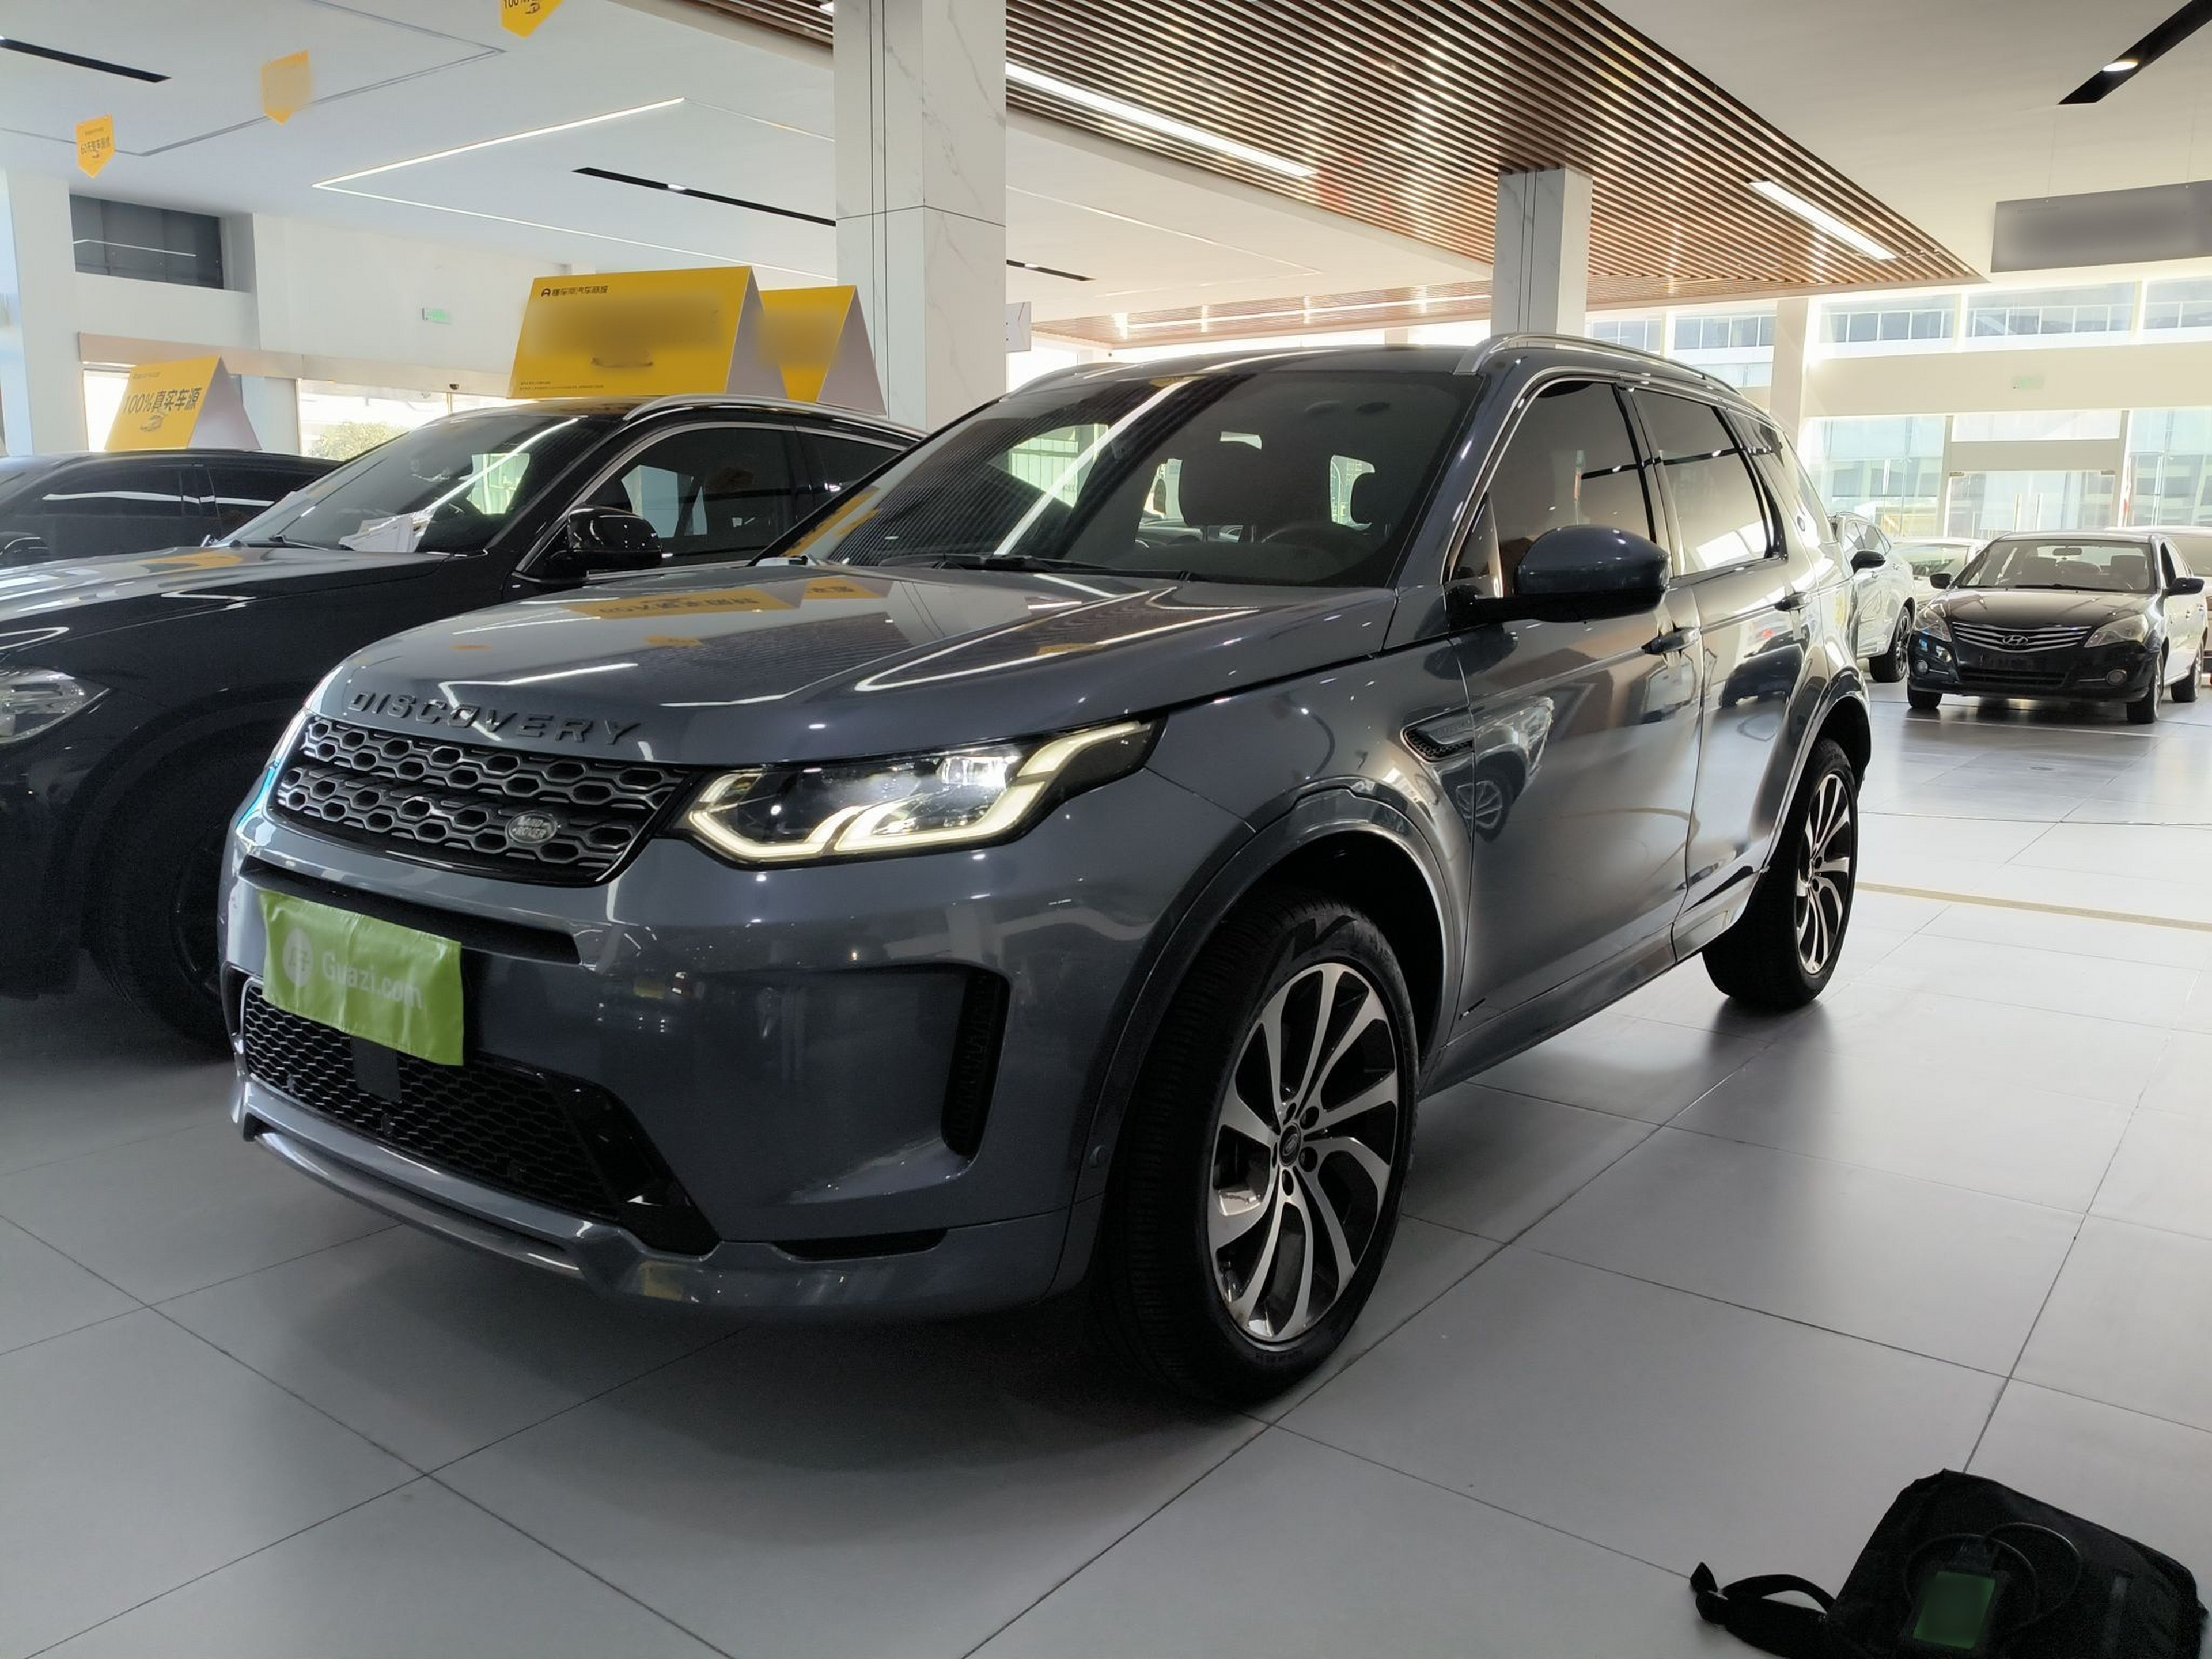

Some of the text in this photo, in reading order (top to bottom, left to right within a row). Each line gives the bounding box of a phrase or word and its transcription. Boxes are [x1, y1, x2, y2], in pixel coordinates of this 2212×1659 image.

[123, 387, 202, 414] 100%真实车源
[348, 692, 641, 745] DISCOVERY
[321, 951, 423, 1009] Guazi.com
